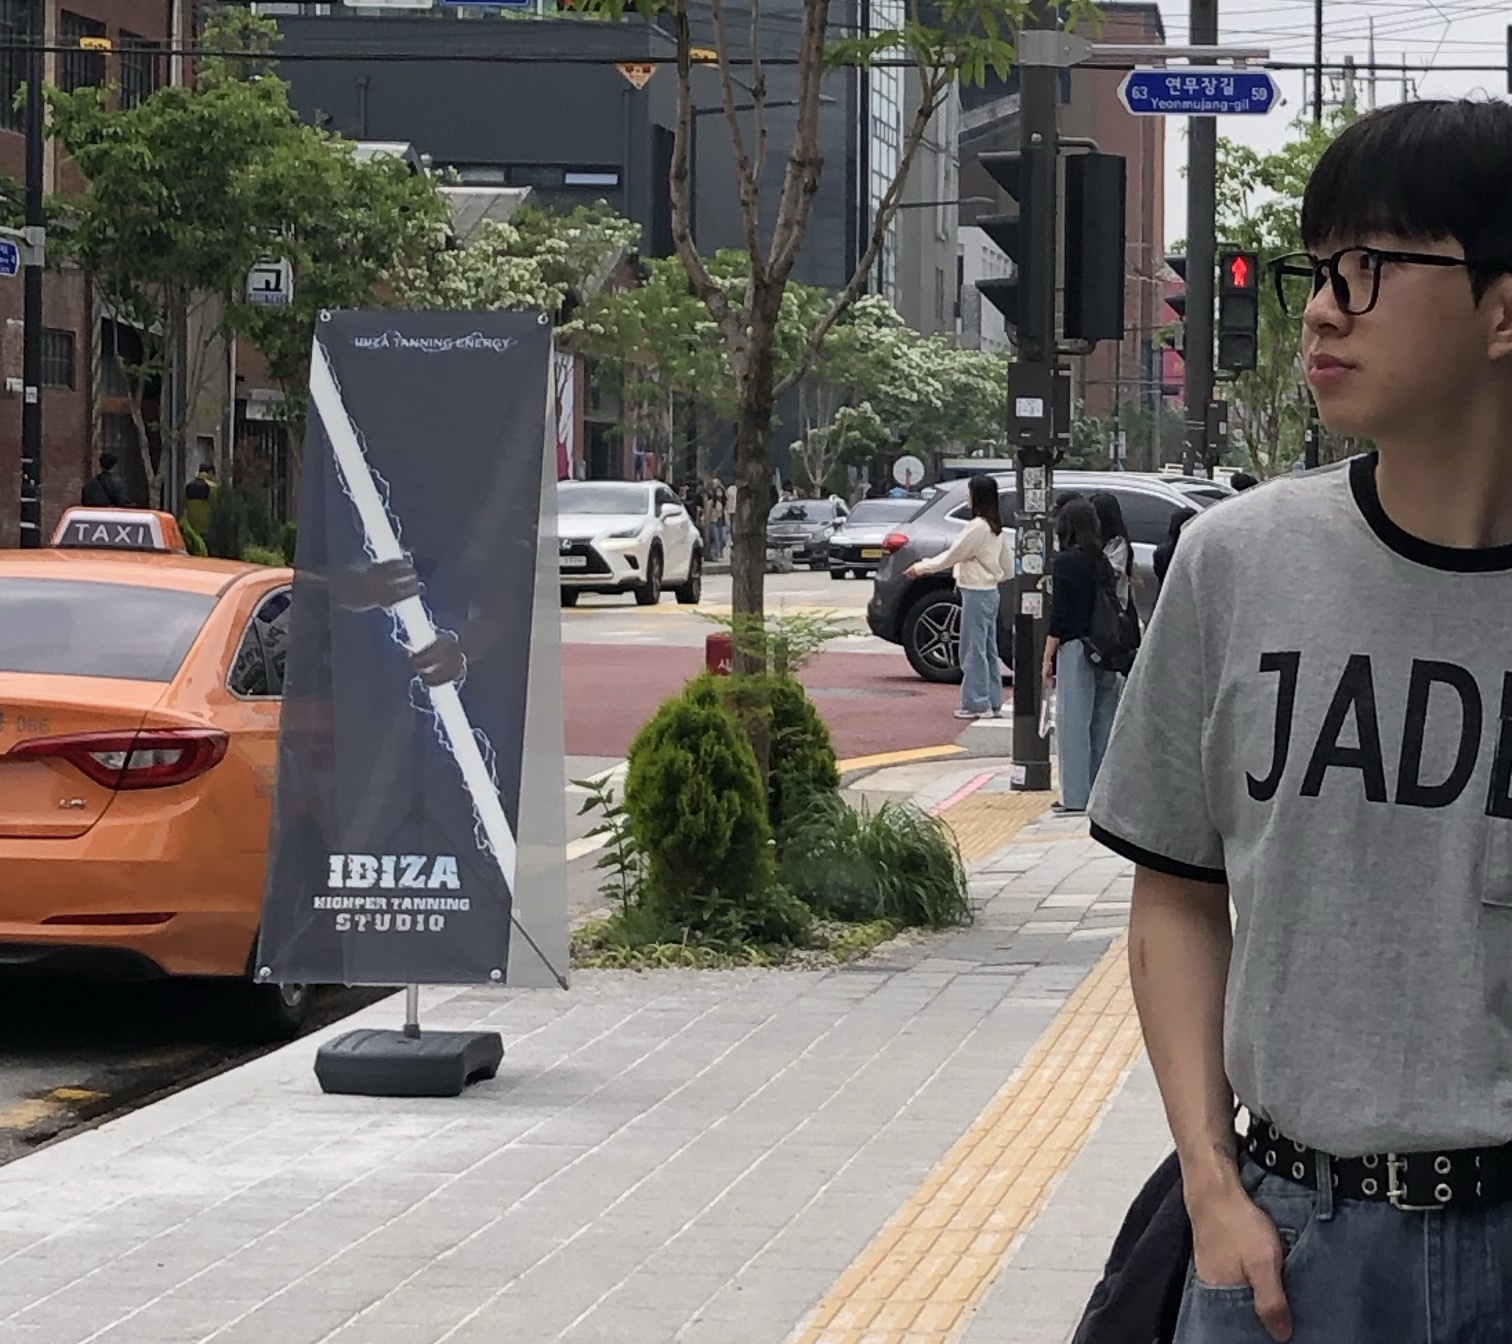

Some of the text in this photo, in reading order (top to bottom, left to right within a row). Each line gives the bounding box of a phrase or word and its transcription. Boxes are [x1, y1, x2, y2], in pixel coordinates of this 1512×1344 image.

[1131, 86, 1148, 100] 63
[1165, 77, 1234, 96] 연무장길
[1150, 97, 1250, 112] Yeonmujang-gil
[394, 336, 453, 349] TANNING
[456, 336, 511, 349] ENERGY
[75, 523, 145, 544] TAXI
[328, 854, 461, 890] IBIZA
[390, 897, 471, 911] TANNING
[335, 912, 445, 932] STUDIO
